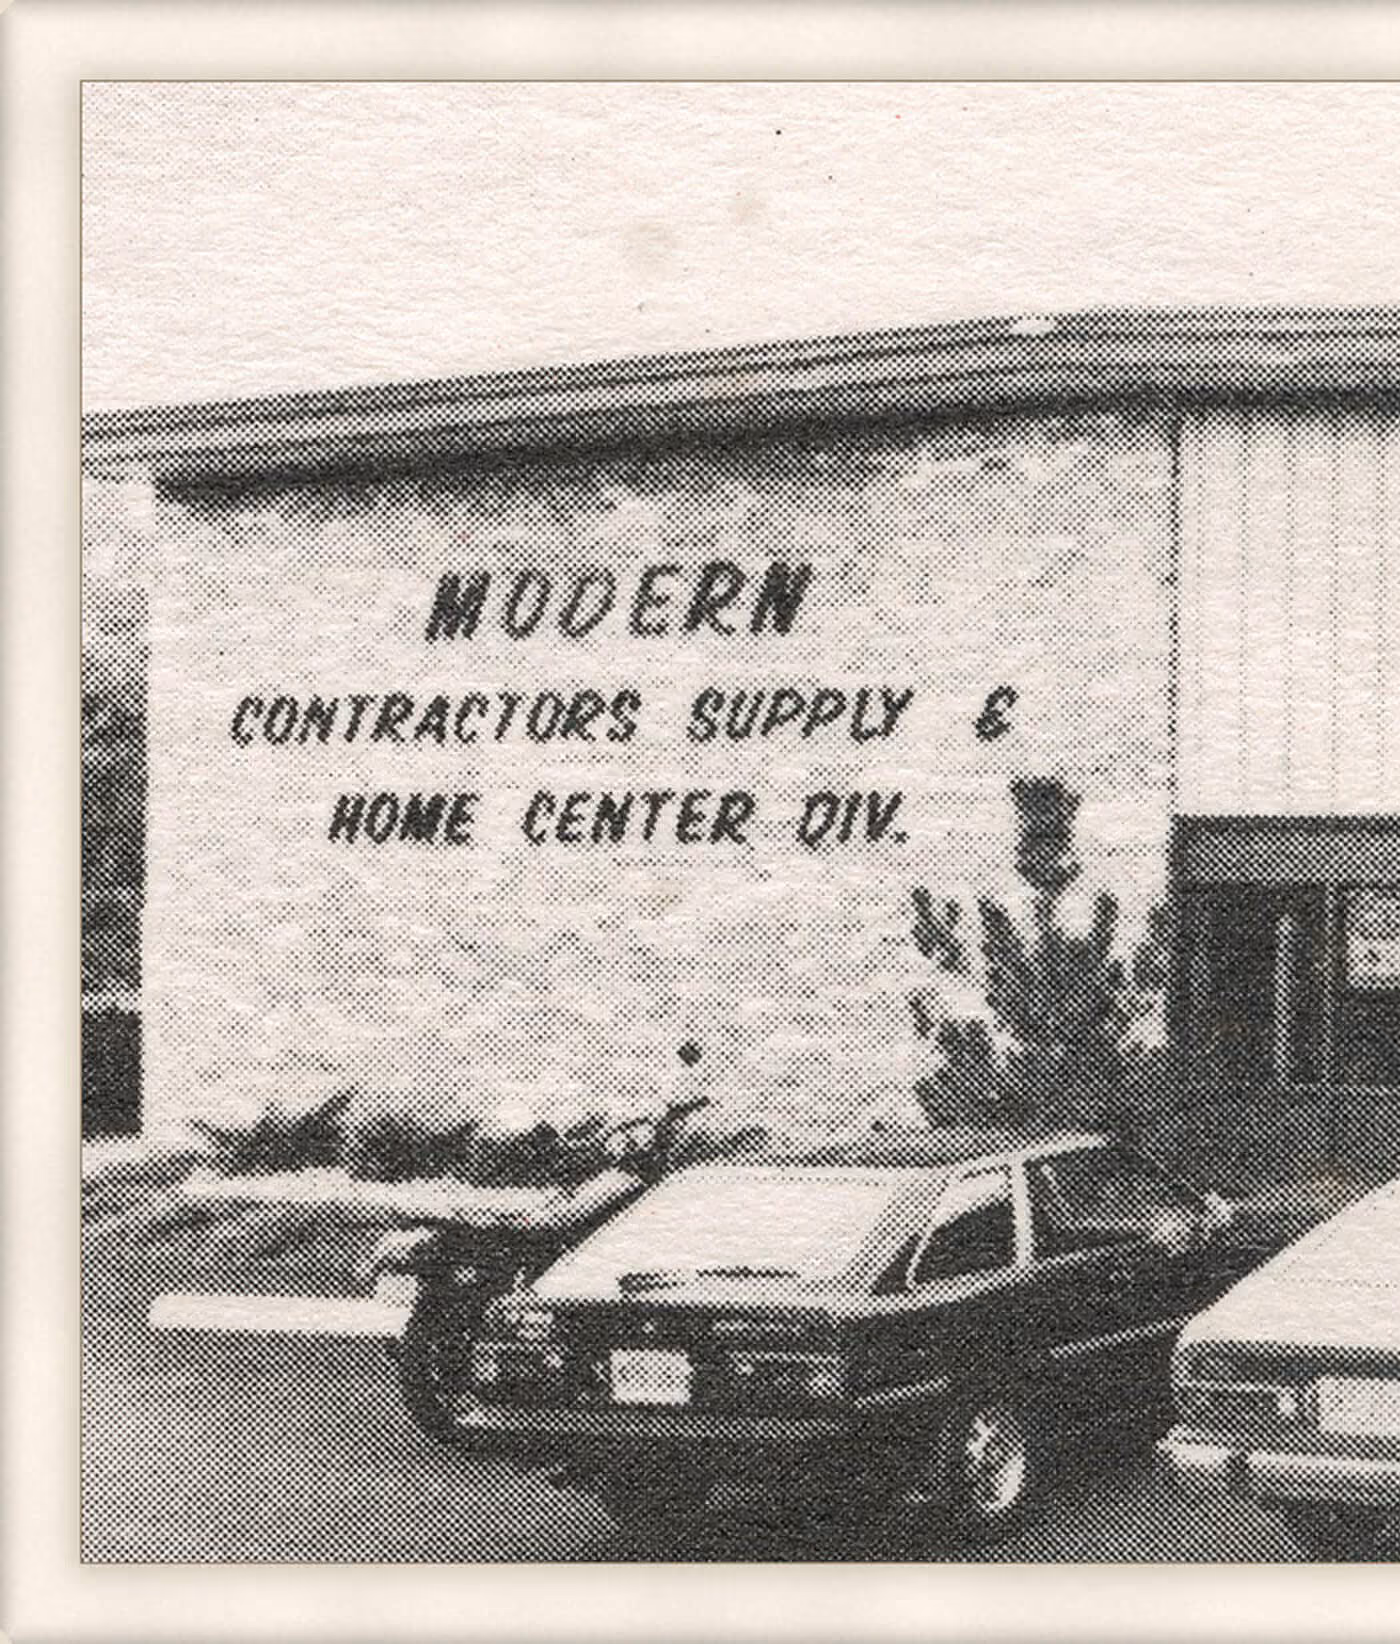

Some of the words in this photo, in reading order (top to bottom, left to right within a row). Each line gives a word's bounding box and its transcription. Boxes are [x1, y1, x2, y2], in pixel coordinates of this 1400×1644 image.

[425, 562, 812, 643] MODERN
[231, 690, 642, 747] CONTRACTORS
[686, 687, 914, 742] SUPPLY
[974, 687, 1018, 741] &
[328, 792, 480, 846] HOME
[522, 790, 758, 846] CENTER
[796, 790, 910, 848] DIV.
